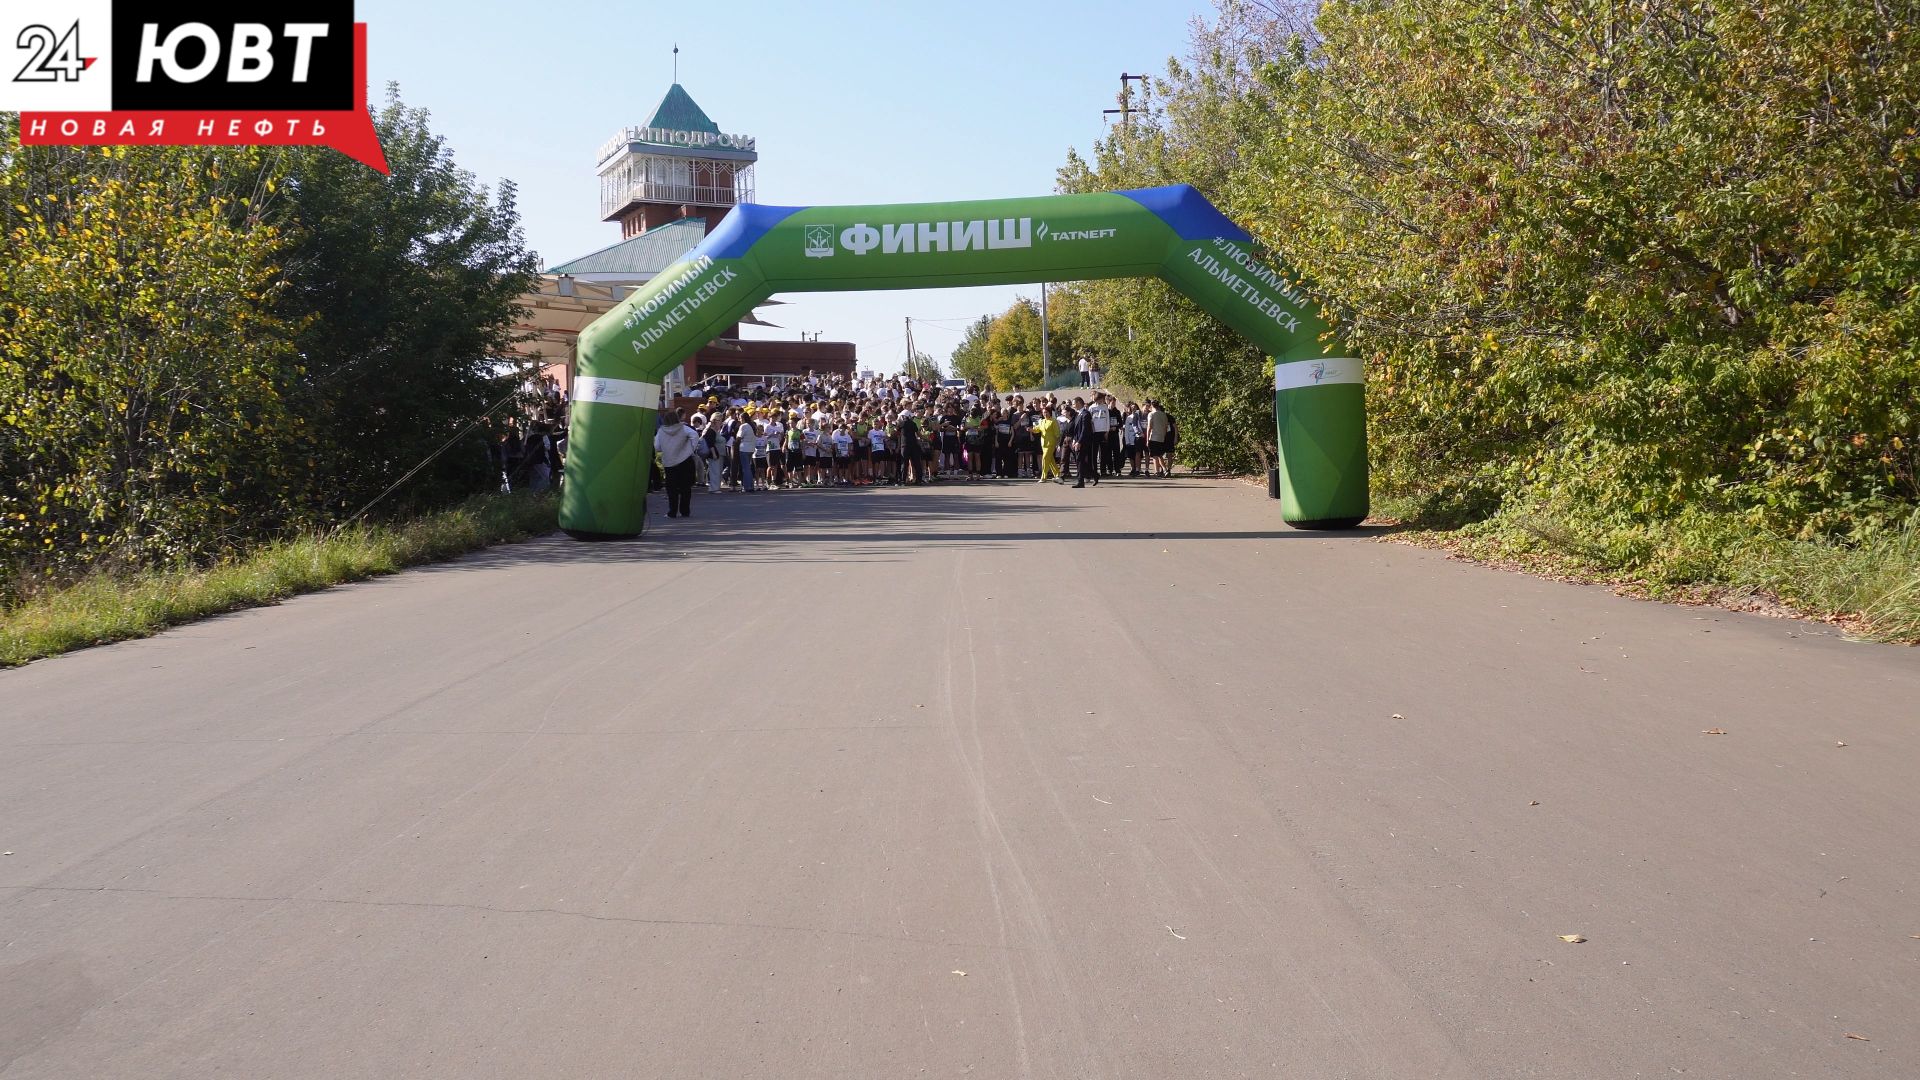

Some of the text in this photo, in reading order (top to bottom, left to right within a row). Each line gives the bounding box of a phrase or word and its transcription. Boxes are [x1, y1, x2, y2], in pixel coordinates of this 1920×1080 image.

[839, 217, 1032, 255] ФИНИШ
[1050, 228, 1117, 242] TATNEFT
[623, 254, 715, 330] #ЛЮБИМЫЙ
[631, 265, 738, 354] АЛЬМЕТЬЕВСК
[1187, 247, 1302, 334] АЛЬМЕТЬЕВСК
